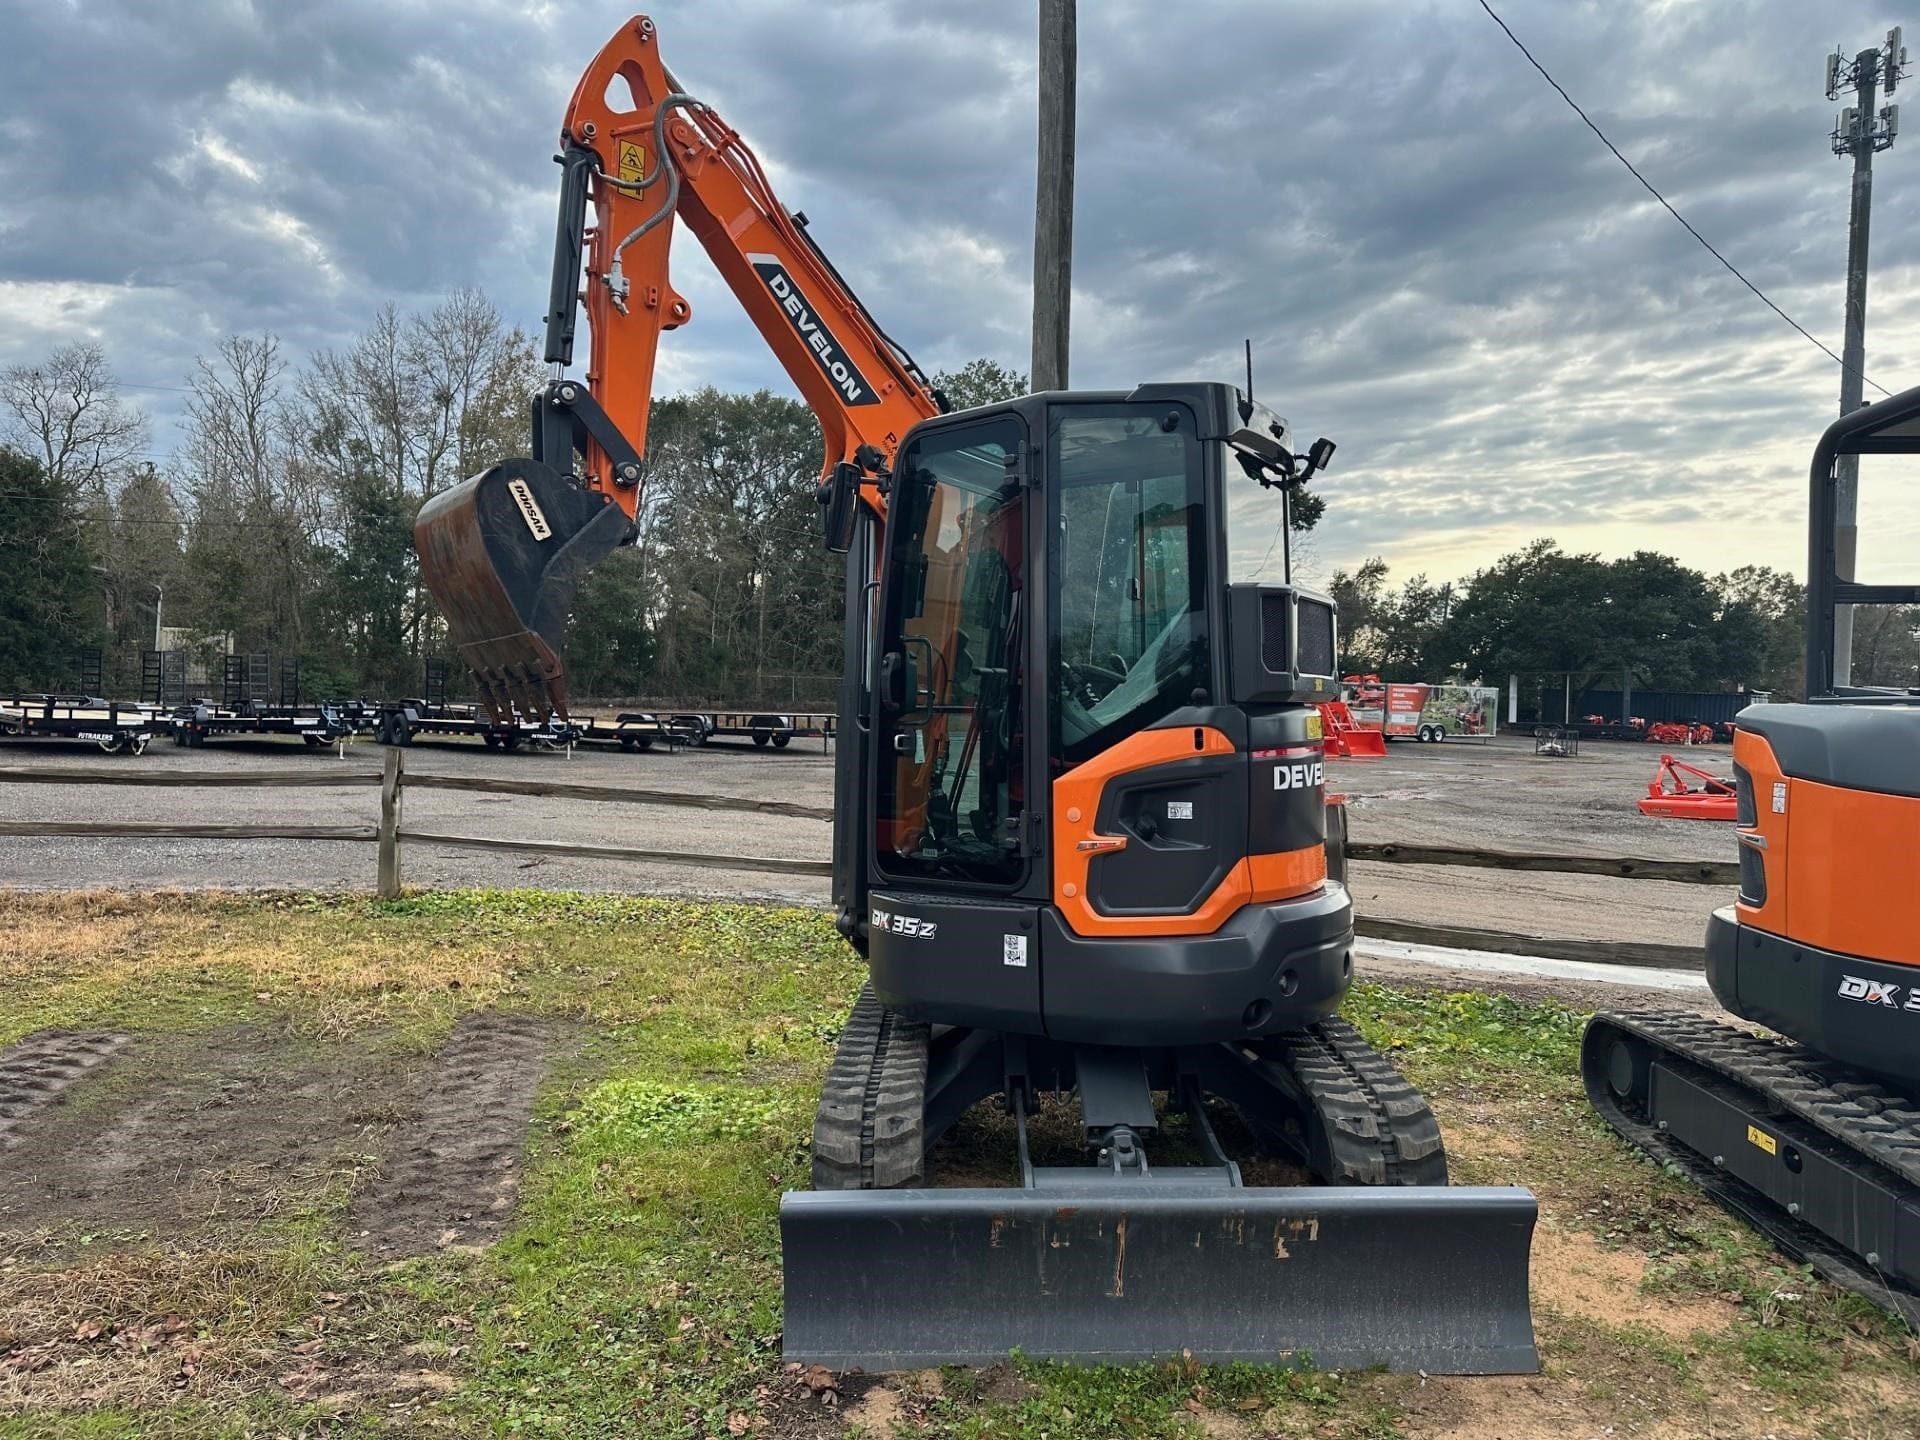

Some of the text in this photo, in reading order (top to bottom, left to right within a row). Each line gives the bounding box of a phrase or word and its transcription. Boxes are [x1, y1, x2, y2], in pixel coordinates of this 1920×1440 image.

[768, 273, 862, 401] DEVELON
[514, 485, 546, 534] DOOSAN
[891, 914, 938, 940] 35Z
[1838, 974, 1900, 1009] DX
